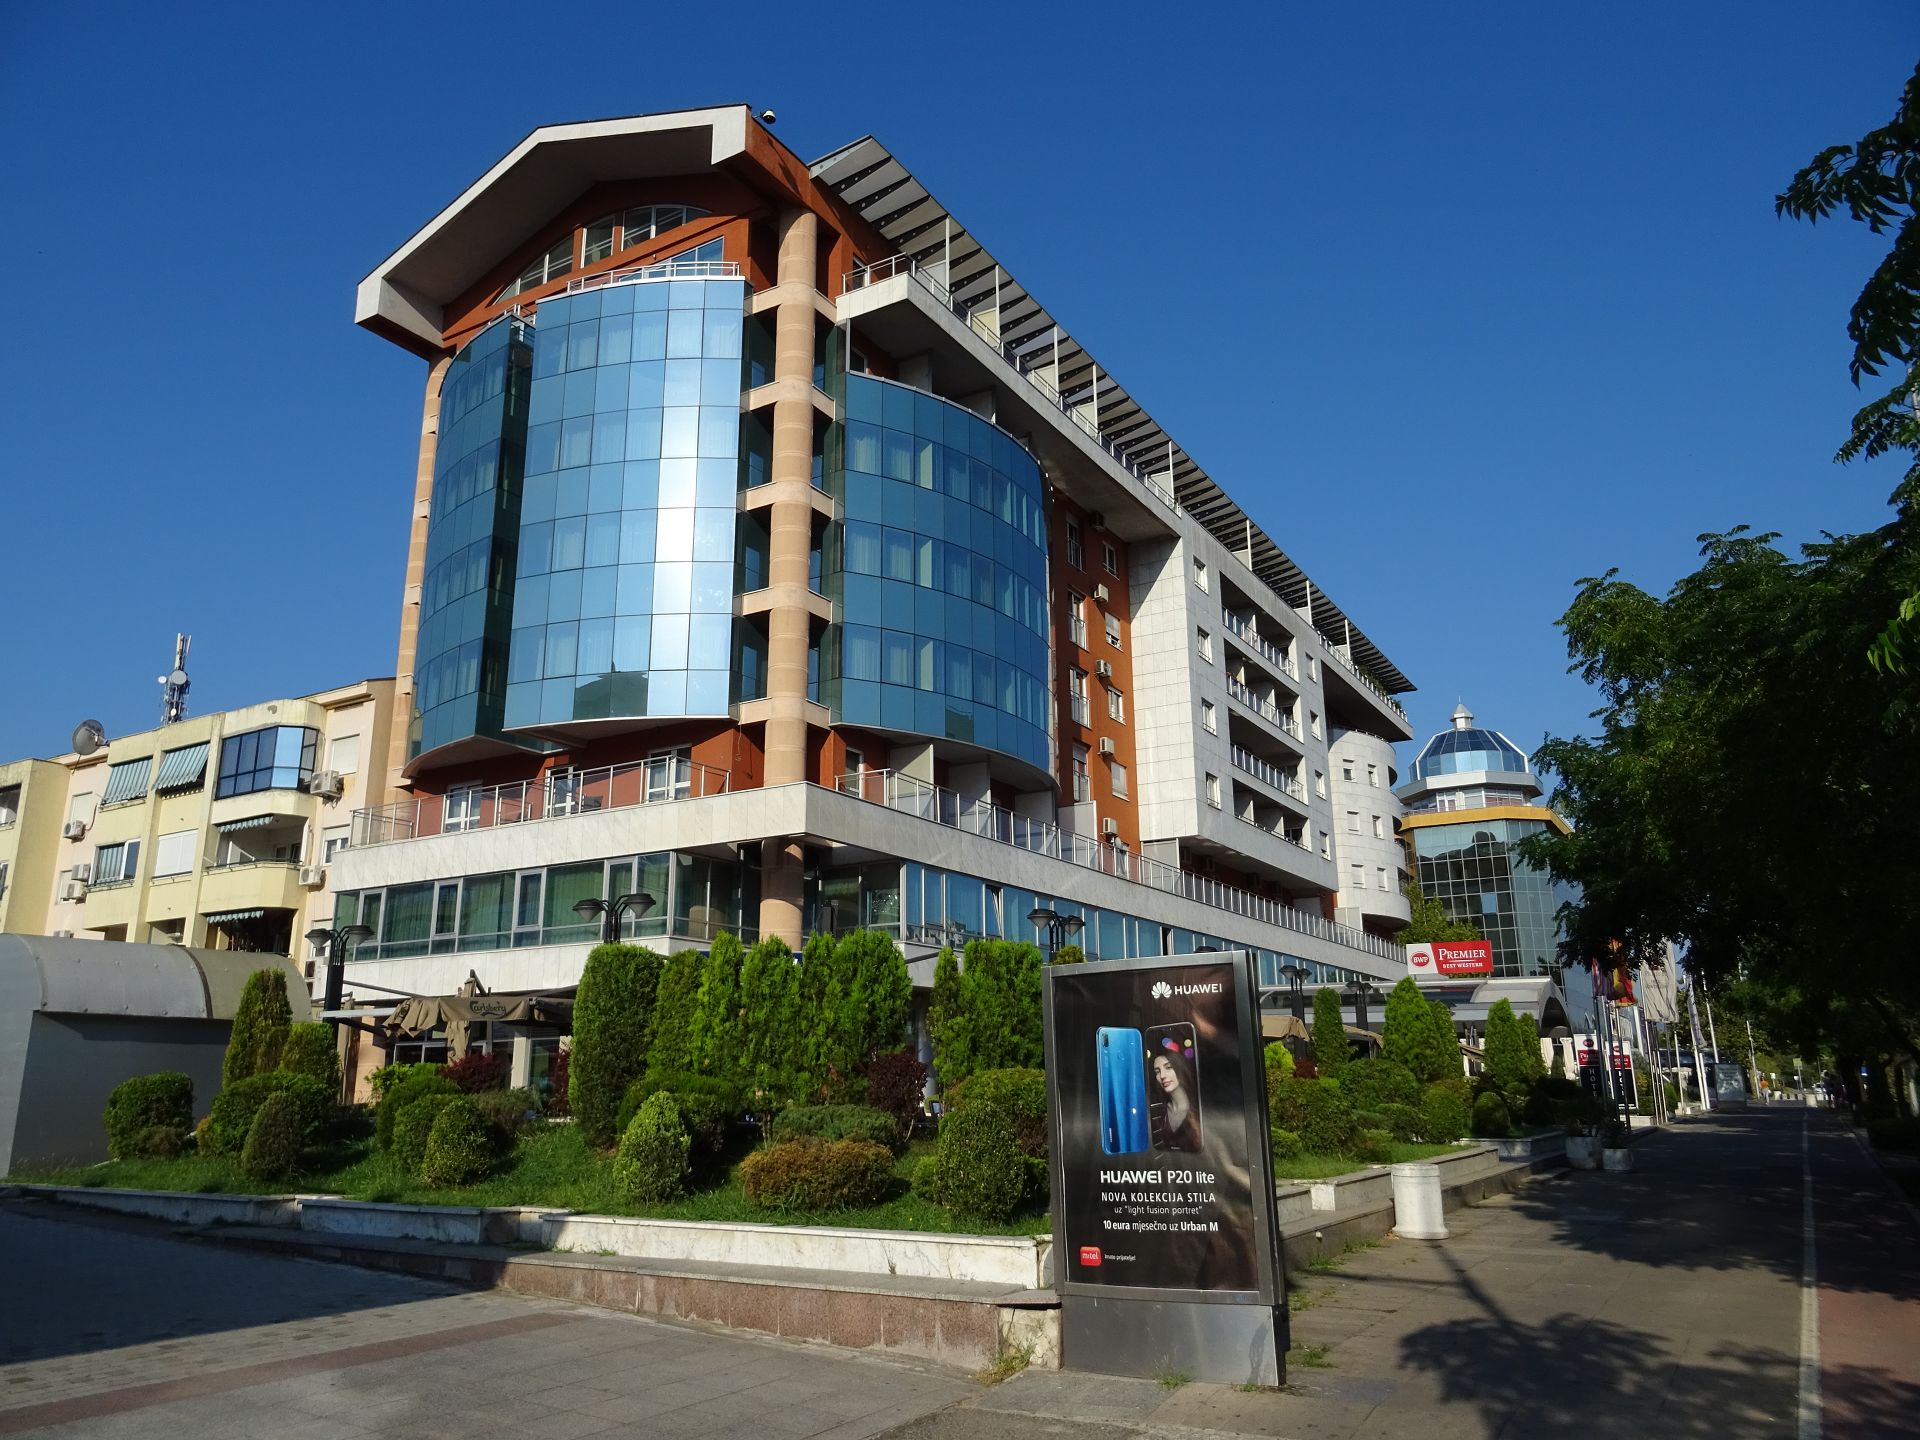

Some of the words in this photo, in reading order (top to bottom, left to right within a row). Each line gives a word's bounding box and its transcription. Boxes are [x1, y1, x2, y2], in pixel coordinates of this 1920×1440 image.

[1438, 948, 1487, 960] PREMIER
[1174, 983, 1223, 995] HUAWEI
[470, 1000, 506, 1018] Carlsberg
[1100, 1170, 1162, 1184] HUAWEI
[1167, 1170, 1193, 1184] P20
[1196, 1171, 1215, 1184] lite
[1101, 1192, 1127, 1202] NOVA
[1131, 1192, 1184, 1203] KOLEKCIJA
[1187, 1192, 1216, 1203] STILA
[1147, 1205, 1170, 1214] fusion
[1103, 1220, 1112, 1230] 10
[1112, 1221, 1130, 1230] eura
[1132, 1220, 1167, 1233] mjesečno
[1169, 1223, 1179, 1231] uz
[1180, 1221, 1207, 1232] Urban
[1209, 1221, 1219, 1232] M
